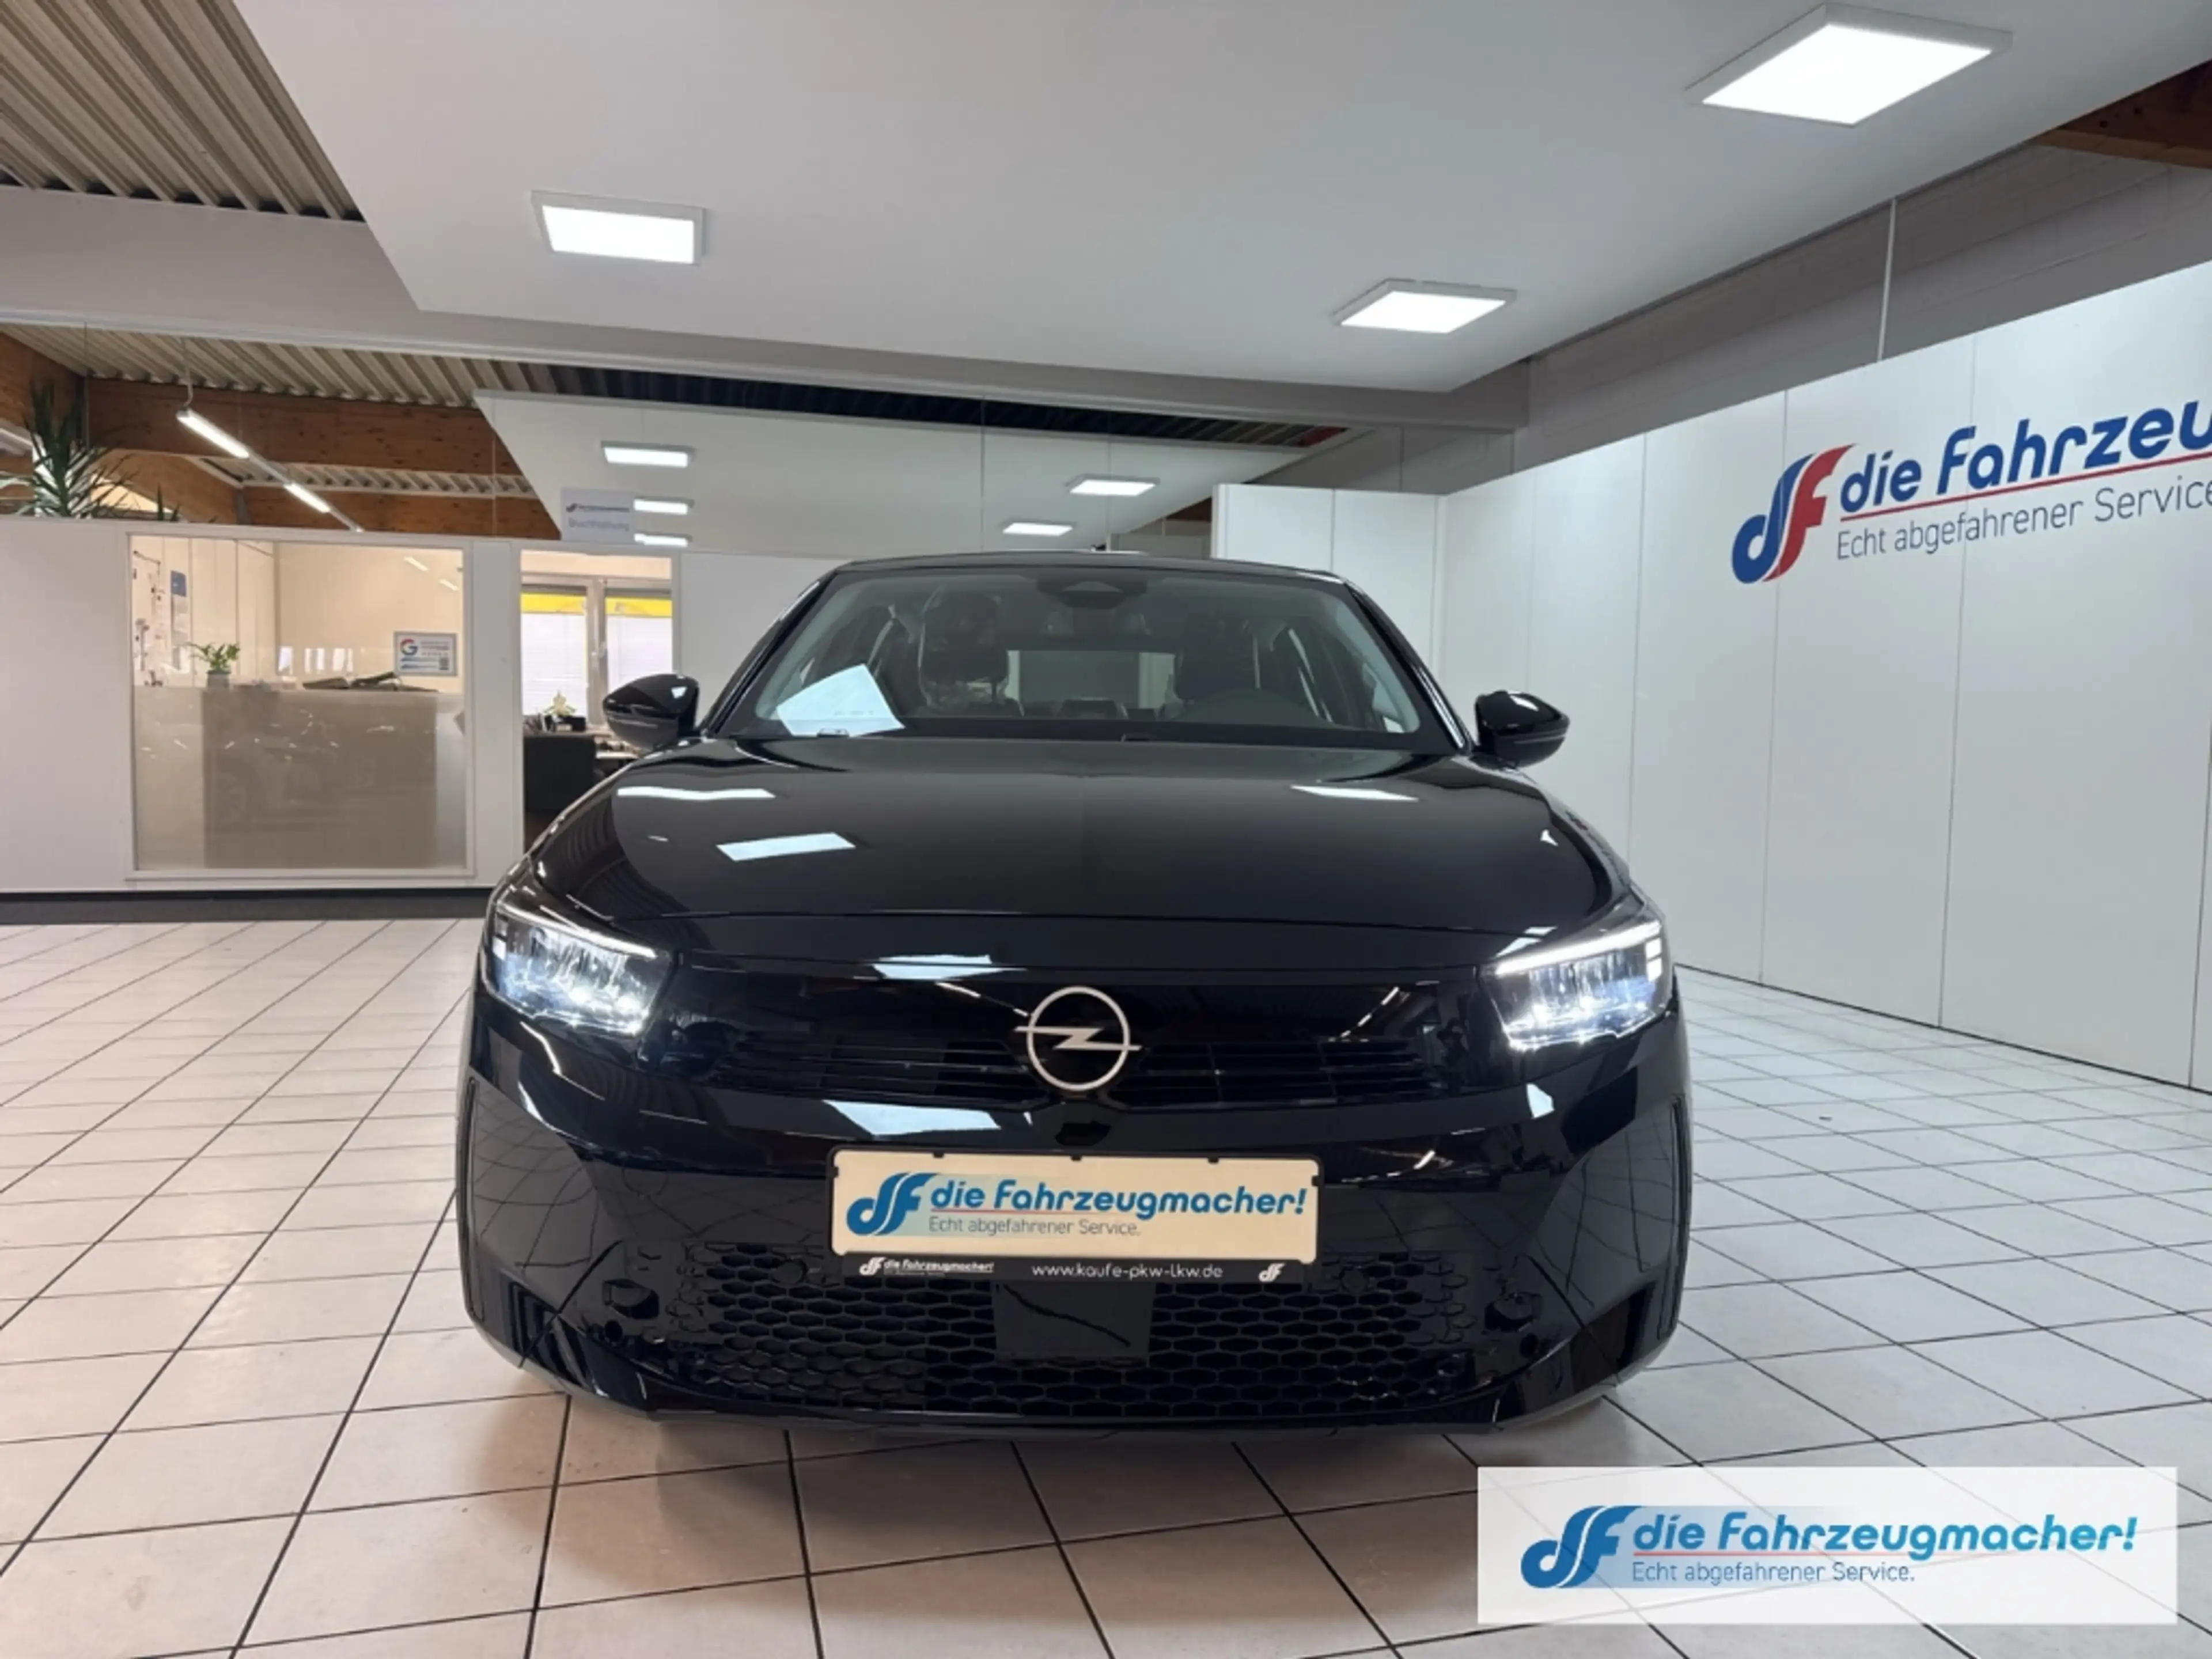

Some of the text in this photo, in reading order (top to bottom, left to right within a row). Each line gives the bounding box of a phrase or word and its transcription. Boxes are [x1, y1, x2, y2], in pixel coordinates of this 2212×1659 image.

[1840, 449, 1922, 513] die
[1836, 528, 1887, 560] Echt
[1894, 500, 2084, 555] abgefahrener
[930, 1179, 1307, 1221] die Fahrzeugmacher!
[929, 1215, 1141, 1236] Echt abgefahrener Service.
[1032, 1263, 1223, 1281] www.kaufe-pkw-lkw.de
